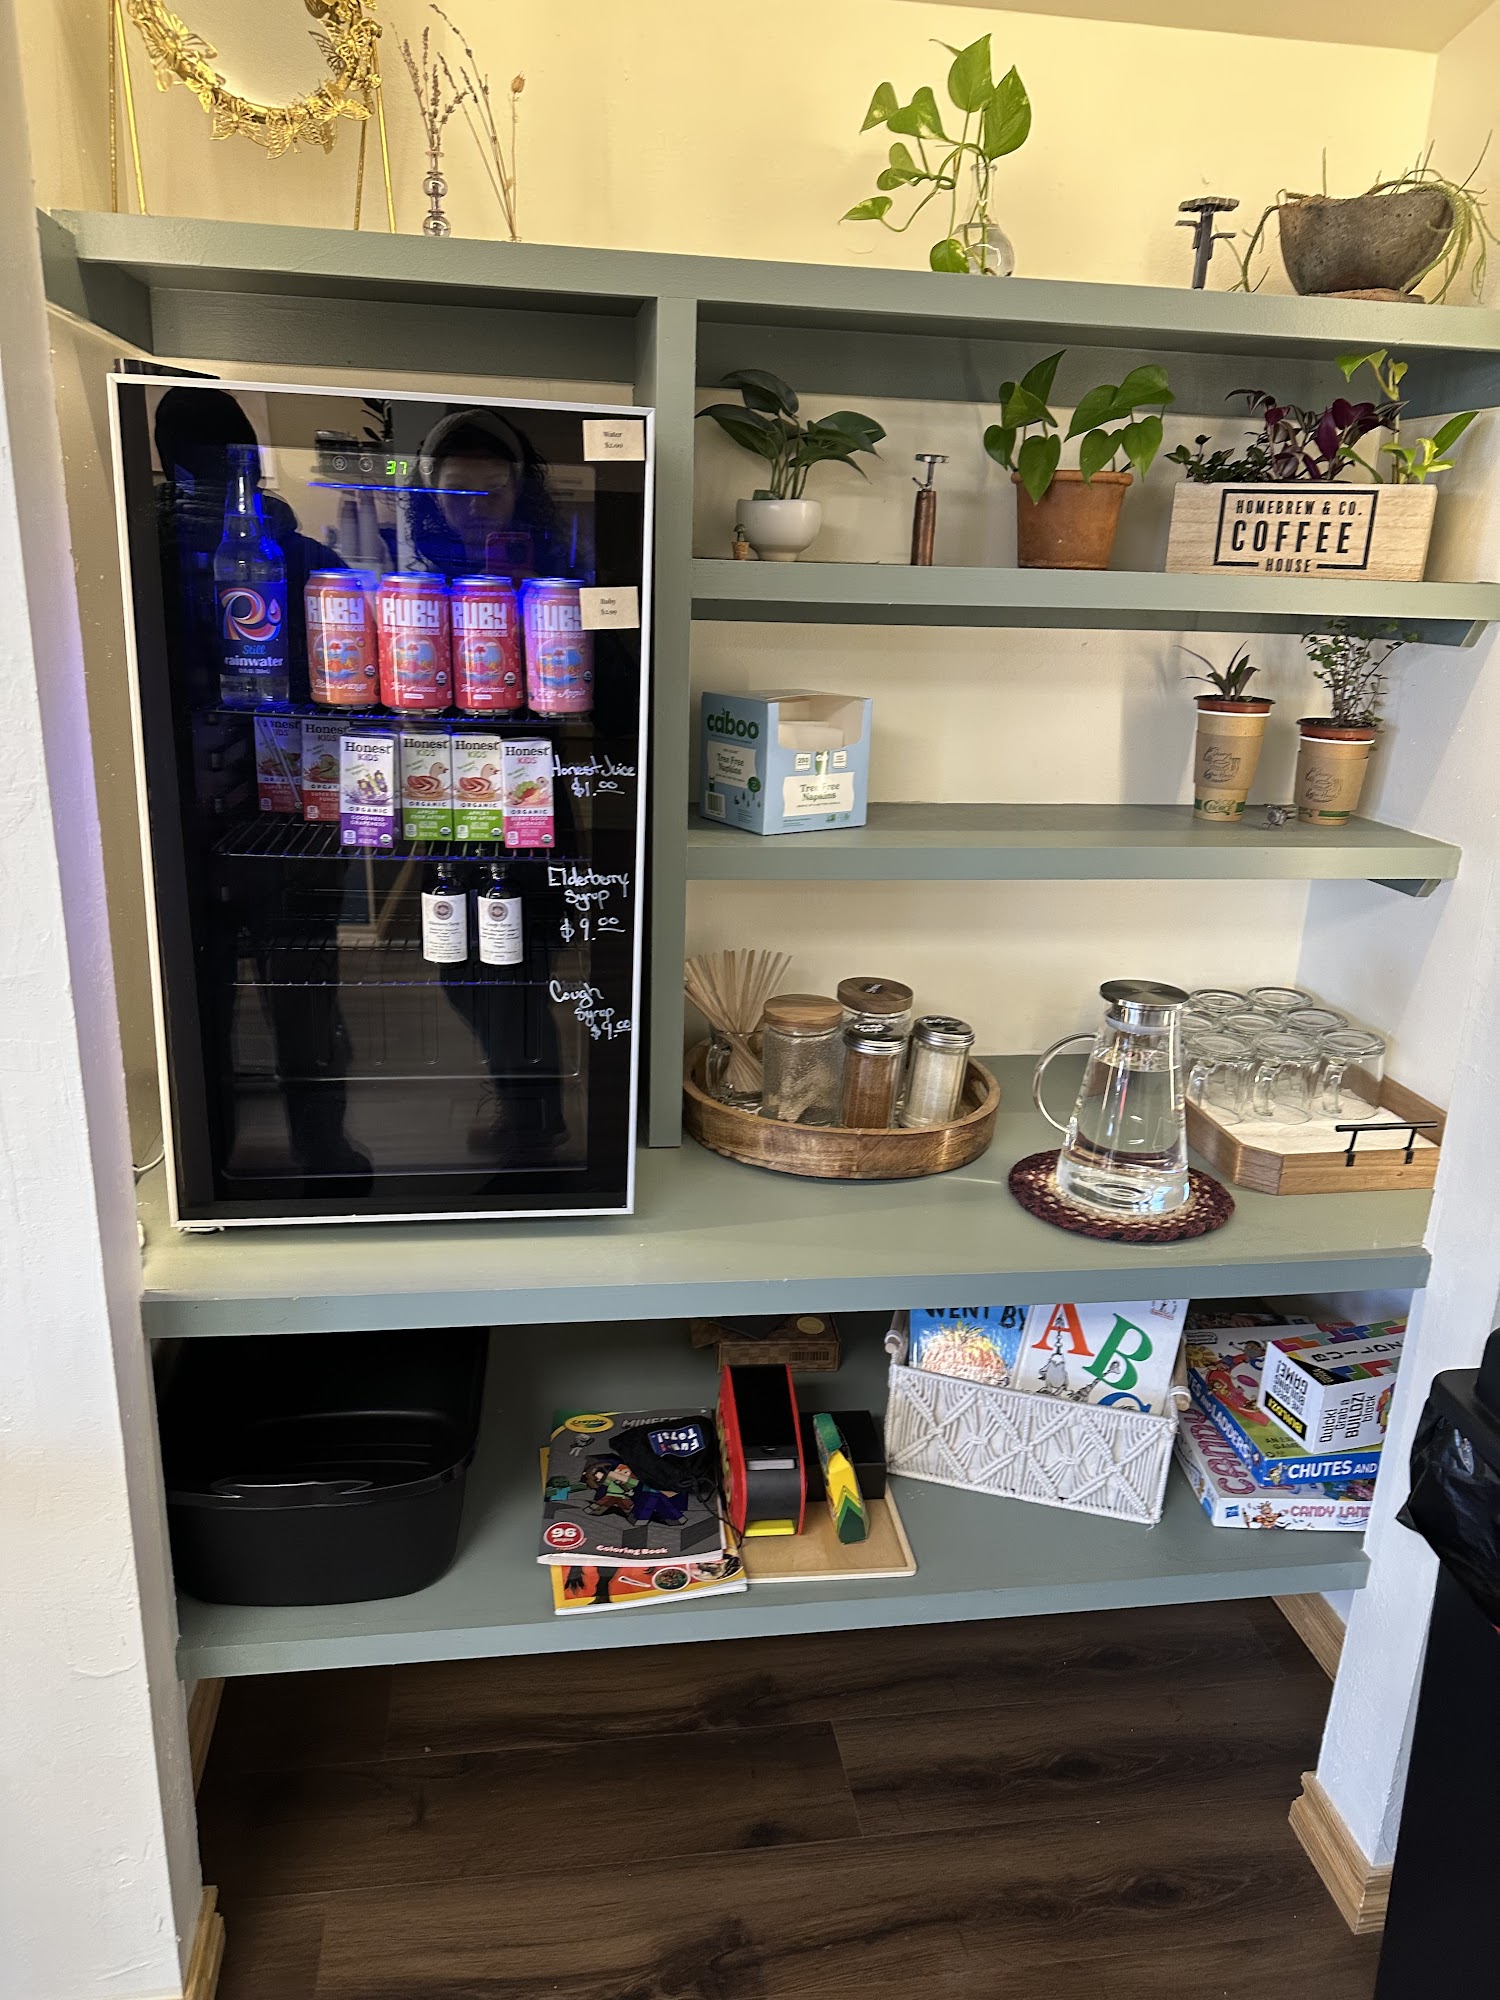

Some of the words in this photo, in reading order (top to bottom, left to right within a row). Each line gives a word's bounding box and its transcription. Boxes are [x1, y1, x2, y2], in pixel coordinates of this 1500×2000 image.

[385, 460, 408, 475] 37
[1236, 499, 1314, 515] HOMEBREW
[1322, 500, 1331, 515] &
[1338, 501, 1362, 516] CO.
[1231, 519, 1353, 554] COFFEE
[1265, 558, 1312, 573] HOUSE
[307, 596, 365, 625] RUBY
[382, 597, 440, 628] RUBY
[451, 601, 507, 629] RUBY
[242, 644, 267, 655] Still
[224, 655, 284, 667] rainwater
[706, 708, 760, 740] caboo
[344, 741, 393, 754] Honest
[403, 738, 449, 749] Honest
[454, 740, 500, 751] Honest
[504, 746, 551, 756] Honest
[358, 753, 380, 761] KIDS
[416, 749, 437, 757] KIDS
[717, 753, 730, 764] Tree
[730, 755, 744, 768] Free
[552, 753, 607, 778] Honest
[601, 754, 636, 778] Juice
[718, 763, 742, 776] Napkins
[348, 806, 388, 814] ORGANIC
[547, 866, 630, 897] Elderberry
[549, 979, 604, 1009] Cough
[1345, 1391, 1366, 1439] BUILDZI
[1361, 1394, 1377, 1423] block
[1320, 1407, 1338, 1442] Quick!
[1335, 1406, 1350, 1430] Grab
[1210, 1402, 1250, 1459] LADDERS
[1288, 1460, 1353, 1479] CHUTES
[1353, 1463, 1378, 1474] AND
[1290, 1505, 1335, 1518] CANDY
[551, 1527, 577, 1538] 96
[596, 1544, 641, 1556] Coloring
